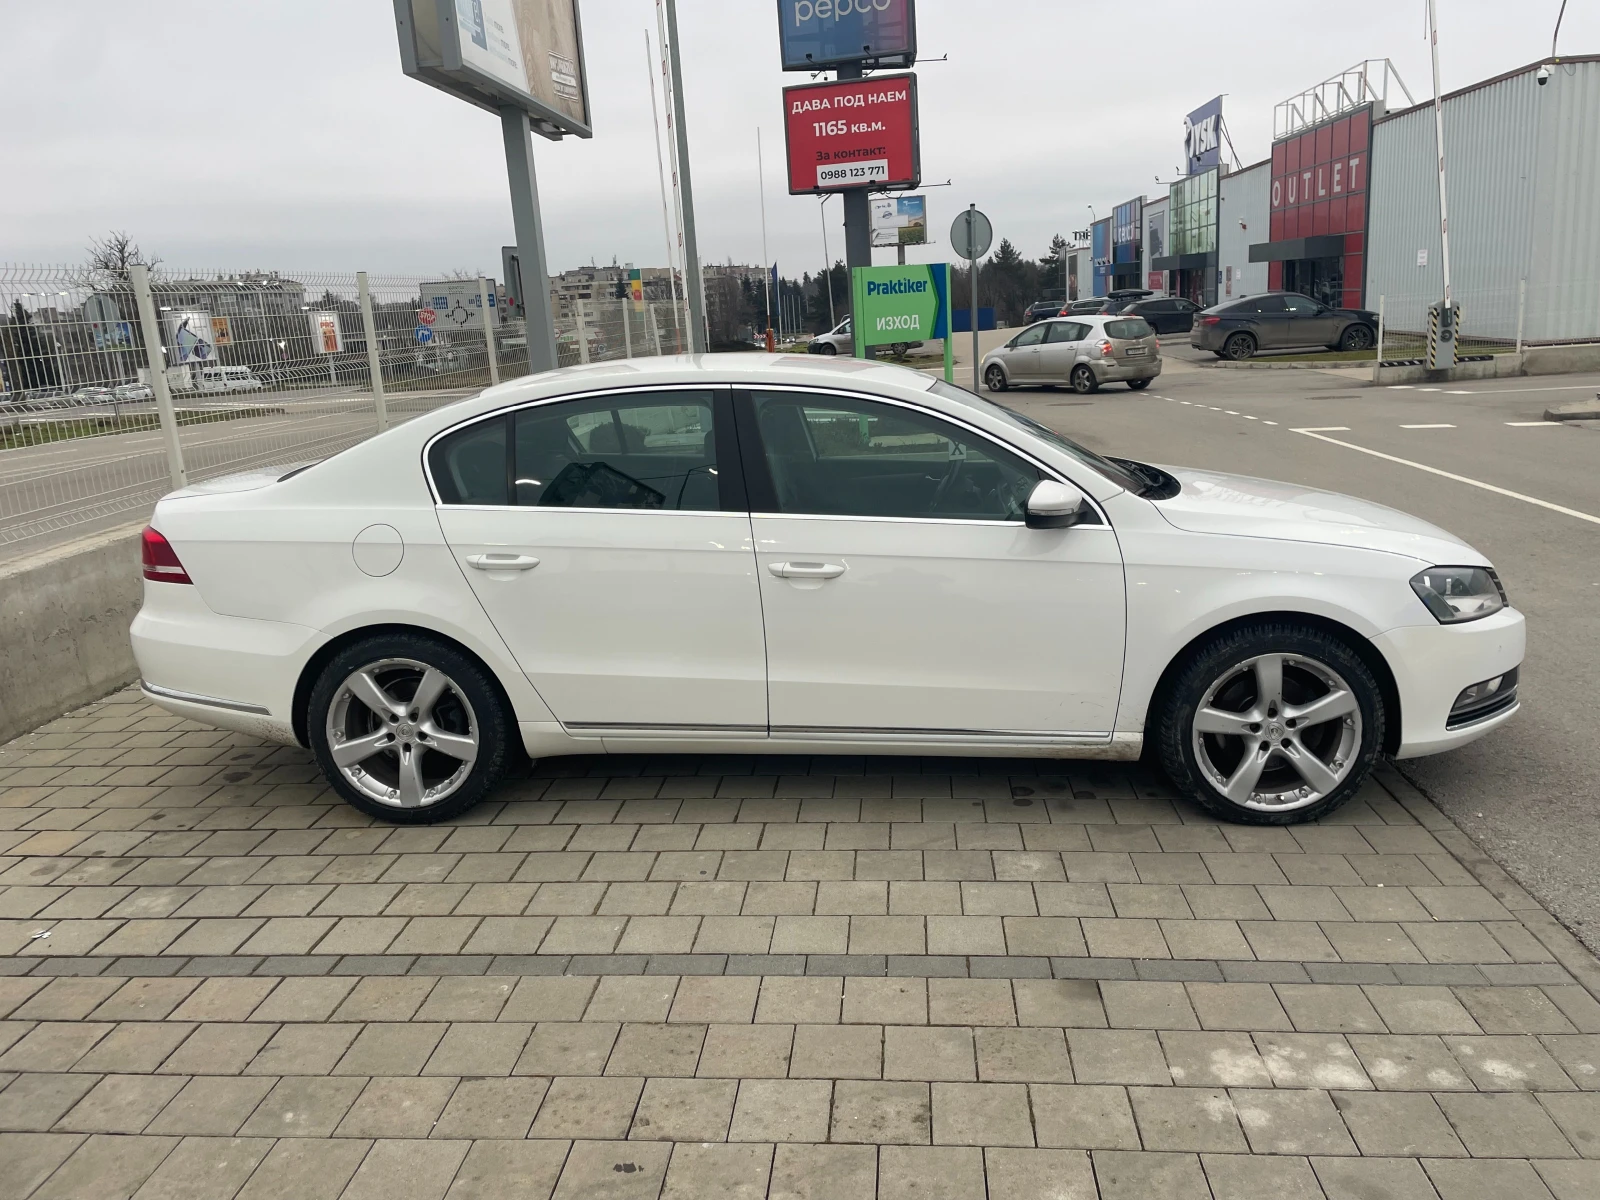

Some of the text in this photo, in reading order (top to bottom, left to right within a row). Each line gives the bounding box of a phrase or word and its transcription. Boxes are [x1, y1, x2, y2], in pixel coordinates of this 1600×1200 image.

[791, 90, 907, 114] ДАВА ПОД НАЕМ
[813, 120, 886, 137] 1165 кв.м.
[816, 146, 886, 161] За контакт:
[820, 165, 885, 180] 0988 123 771
[1272, 157, 1360, 207] OUTLET
[867, 278, 928, 296] Praktiker
[876, 314, 920, 331] ИЗХОД
